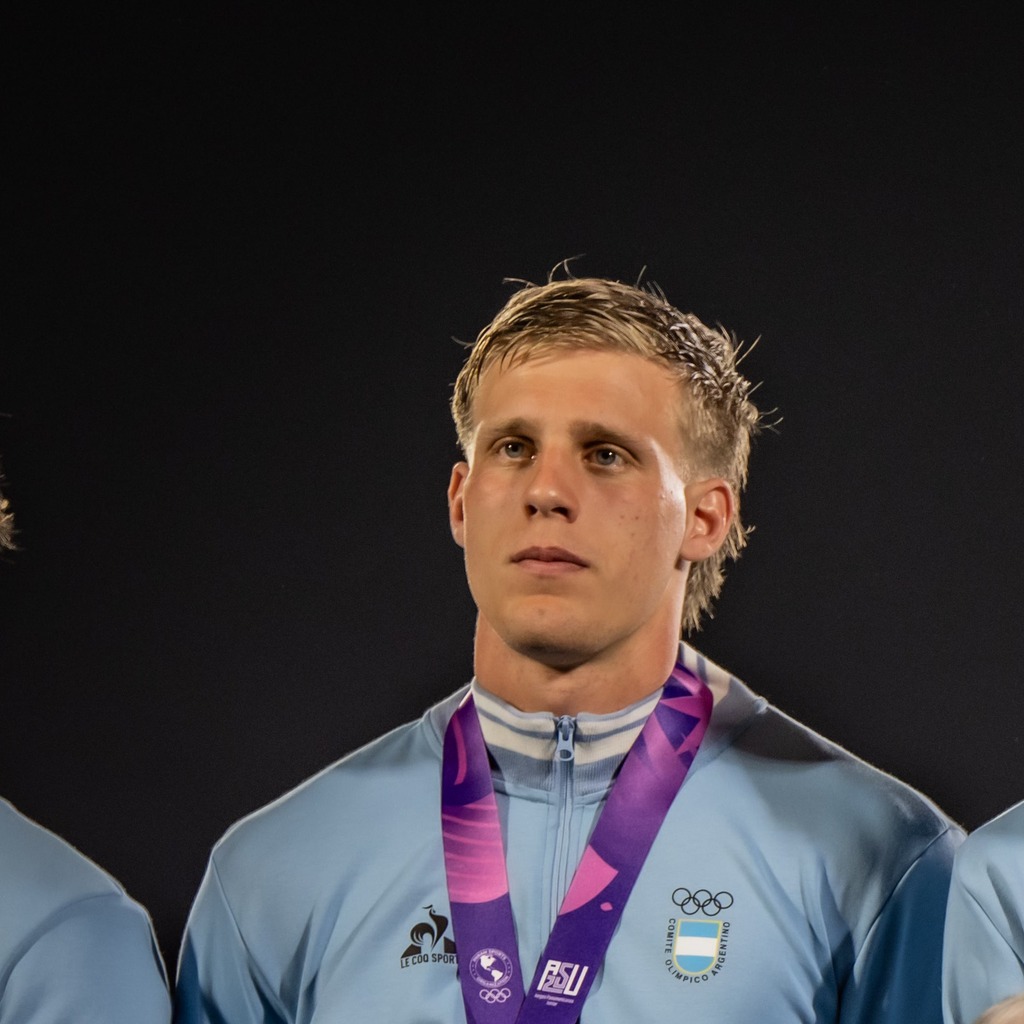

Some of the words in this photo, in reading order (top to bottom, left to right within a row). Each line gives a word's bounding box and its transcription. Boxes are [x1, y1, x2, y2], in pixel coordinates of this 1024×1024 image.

[665, 918, 676, 954] COMITE
[711, 921, 731, 976] ARGENTINO
[400, 957, 410, 969] LE
[411, 953, 429, 966] COQ
[665, 959, 709, 984] OLIMPICO
